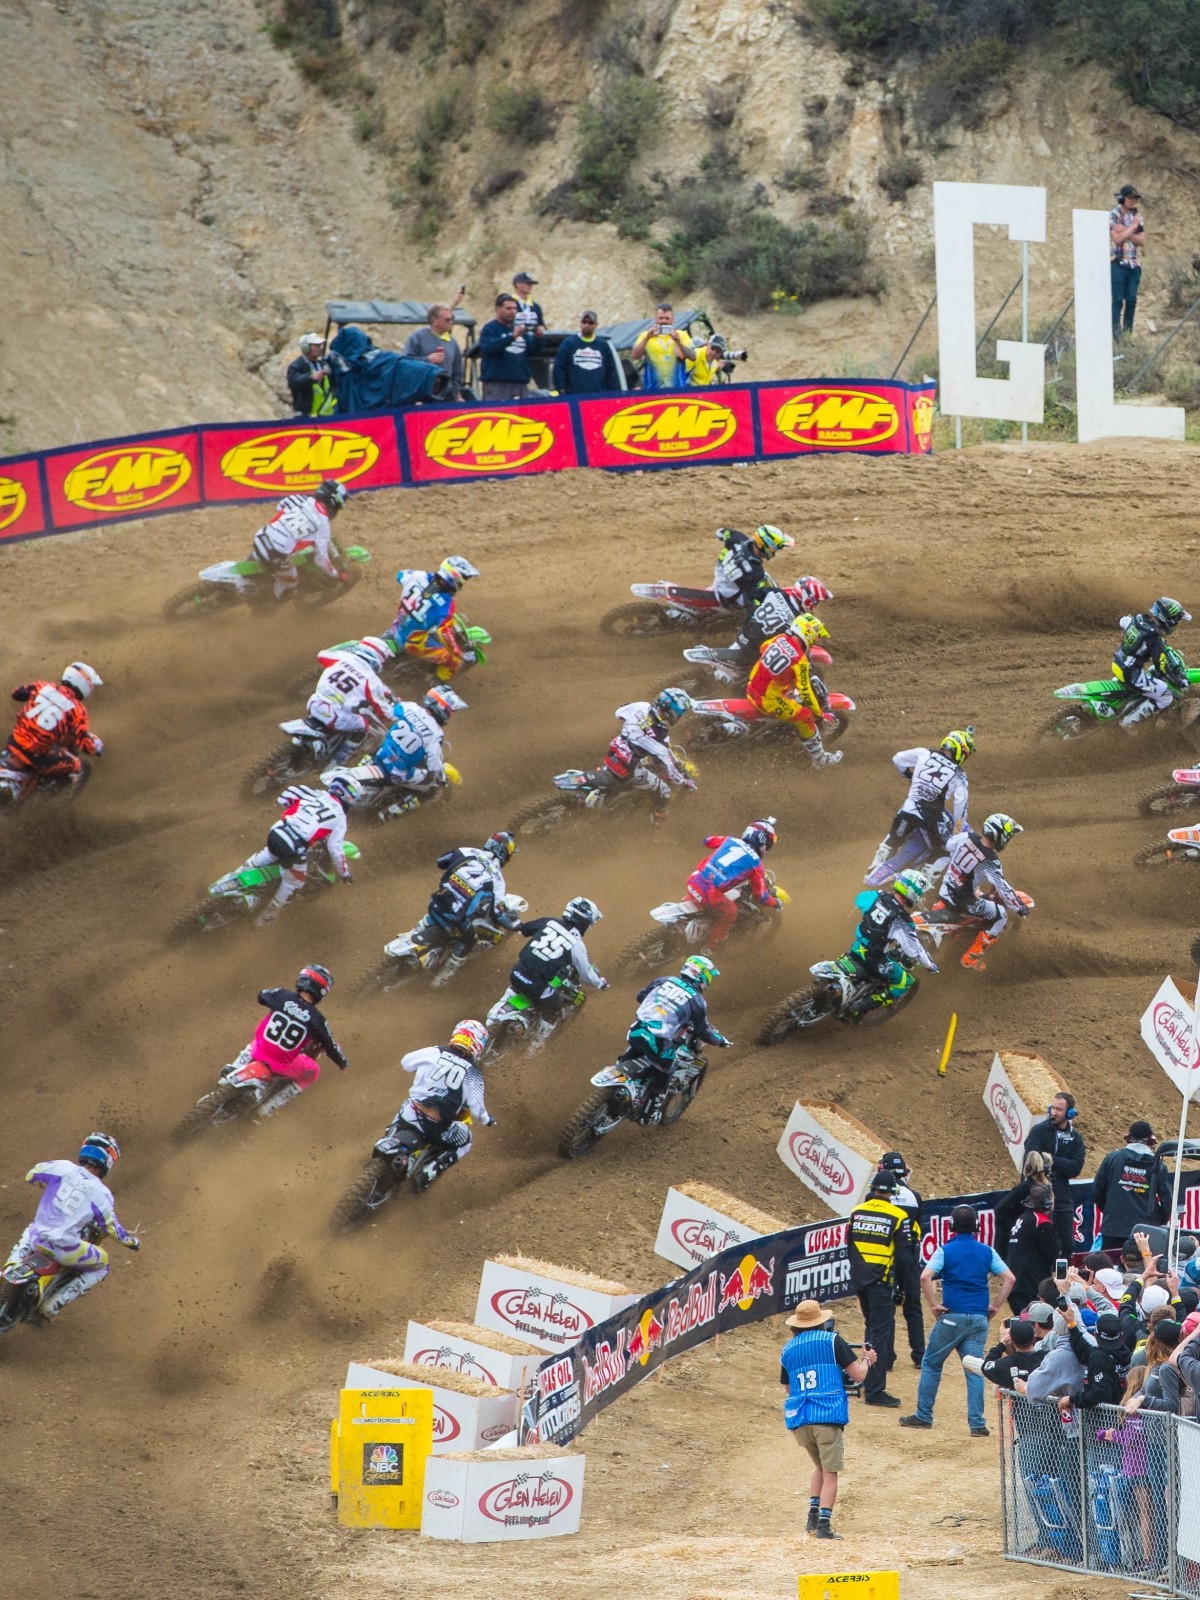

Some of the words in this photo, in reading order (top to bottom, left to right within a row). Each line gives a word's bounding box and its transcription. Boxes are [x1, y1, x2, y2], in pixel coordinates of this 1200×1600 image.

[606, 405, 731, 444] FMF
[778, 397, 894, 431] FMF
[427, 419, 548, 458] FMF
[659, 440, 690, 451] RACING
[818, 431, 852, 440] RACING
[223, 436, 373, 477] FMF
[476, 454, 505, 465] RACING
[67, 452, 187, 502] FMF
[756, 601, 785, 634] 84
[328, 670, 360, 694] 45
[25, 694, 65, 731] 76
[390, 719, 424, 756] 20
[918, 758, 956, 791] 23
[930, 752, 958, 770] PEICK
[954, 845, 979, 874] 10
[455, 860, 493, 891] 21
[530, 926, 573, 962] 35
[657, 980, 692, 1006] 505
[263, 1011, 307, 1051] 39
[431, 1057, 467, 1090] 70
[807, 1231, 842, 1254] LUCAS
[852, 1221, 891, 1235] SUZUKI
[785, 1259, 850, 1294] MOTOCR
[784, 1284, 849, 1306] CHAMPION
[506, 1295, 541, 1320] GLEN
[543, 1298, 580, 1332] HELEN
[797, 1370, 817, 1391] 13
[363, 1470, 400, 1482] Sports
[370, 1462, 398, 1473] NBC
[494, 1487, 530, 1512] GLEN
[531, 1482, 562, 1508] HELEN
[826, 1575, 870, 1583] ACERBIS
